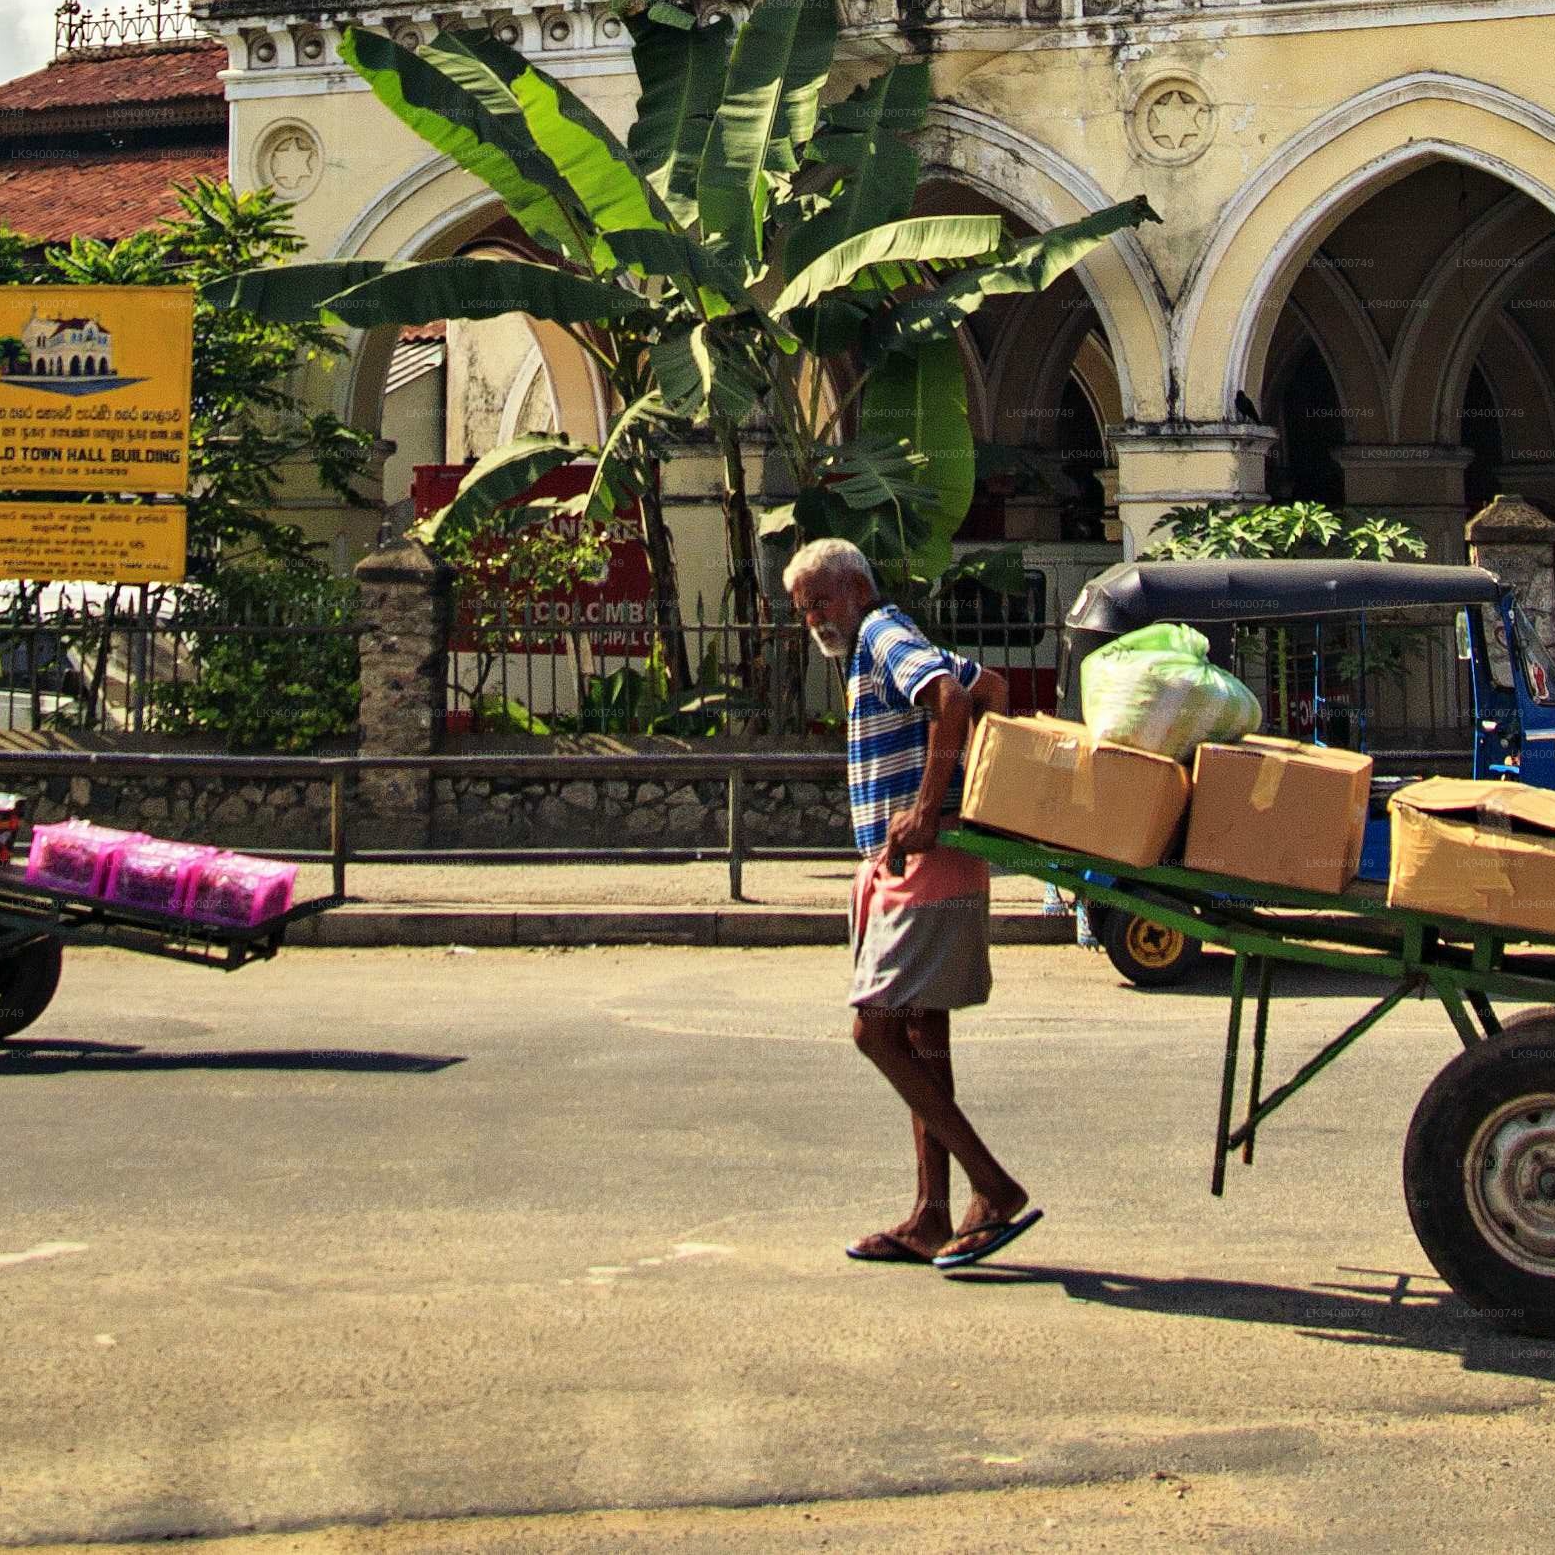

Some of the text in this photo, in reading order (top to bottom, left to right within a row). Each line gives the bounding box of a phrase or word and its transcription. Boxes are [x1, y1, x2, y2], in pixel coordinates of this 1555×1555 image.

[21, 447, 62, 461] TOWN
[66, 448, 106, 462] HALL
[110, 448, 181, 464] BUILDING
